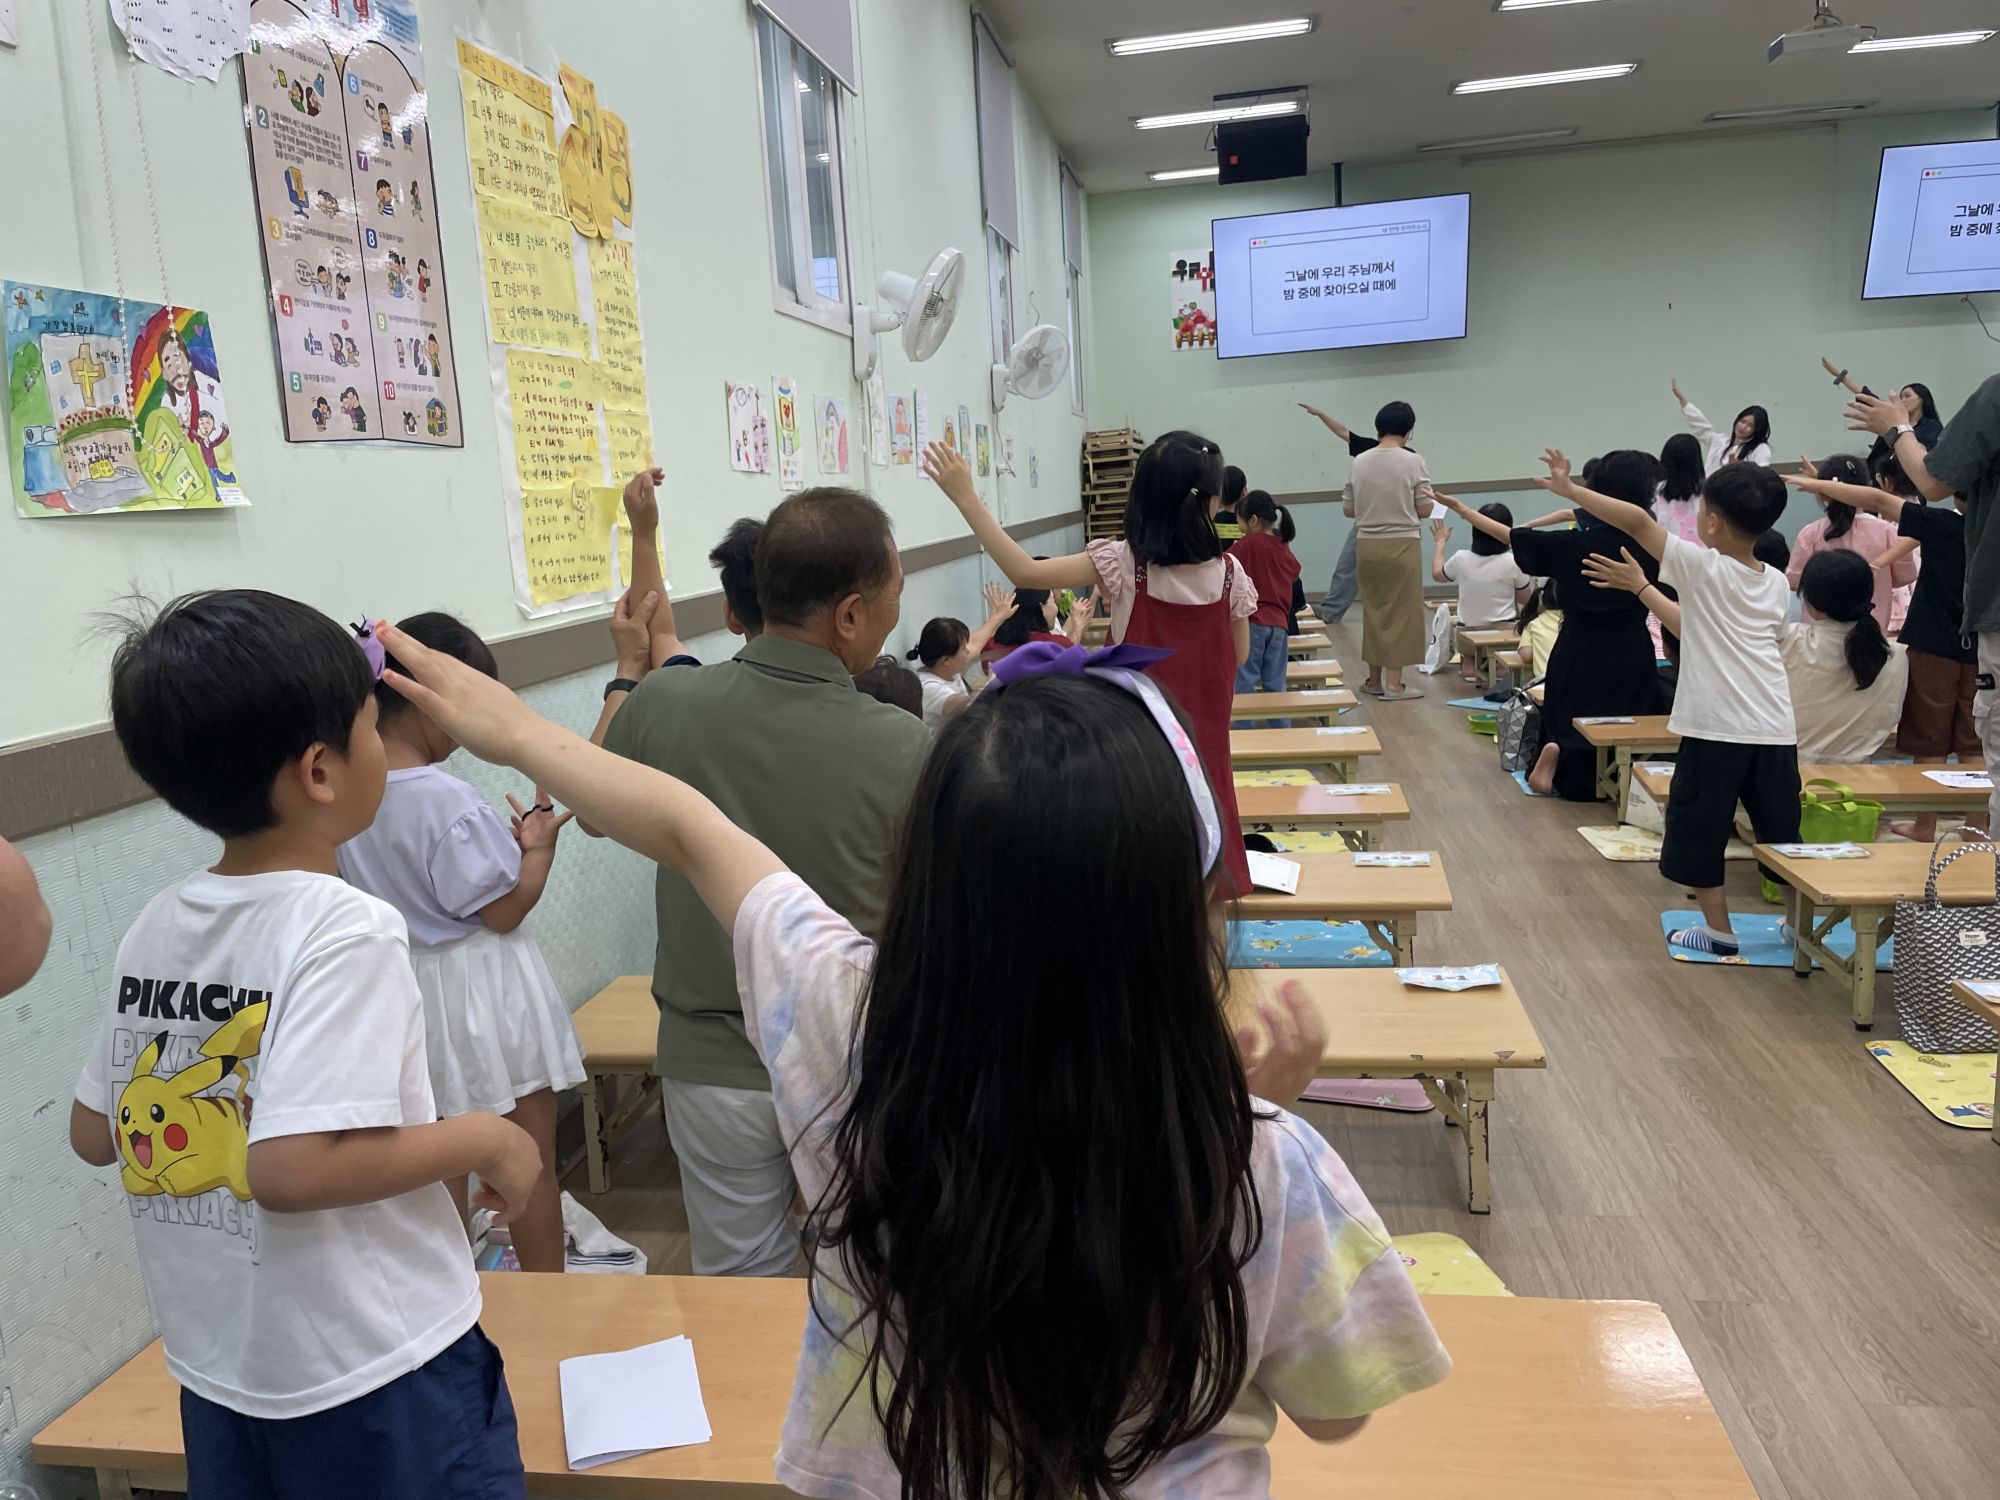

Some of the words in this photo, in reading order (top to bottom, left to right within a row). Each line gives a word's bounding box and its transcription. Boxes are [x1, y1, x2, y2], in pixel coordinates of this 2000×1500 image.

[258, 109, 267, 127] 2
[1953, 203, 1995, 218] 그날에
[1950, 223, 1964, 238] 밤
[1966, 222, 1993, 236] 중에
[1284, 268, 1319, 283] 그날에
[1321, 265, 1345, 280] 우리
[1347, 260, 1395, 277] 주님께서
[1283, 287, 1295, 301] 밤
[1298, 286, 1321, 300] 중에
[1323, 281, 1370, 297] 찾아오실
[1372, 278, 1397, 292] 때에
